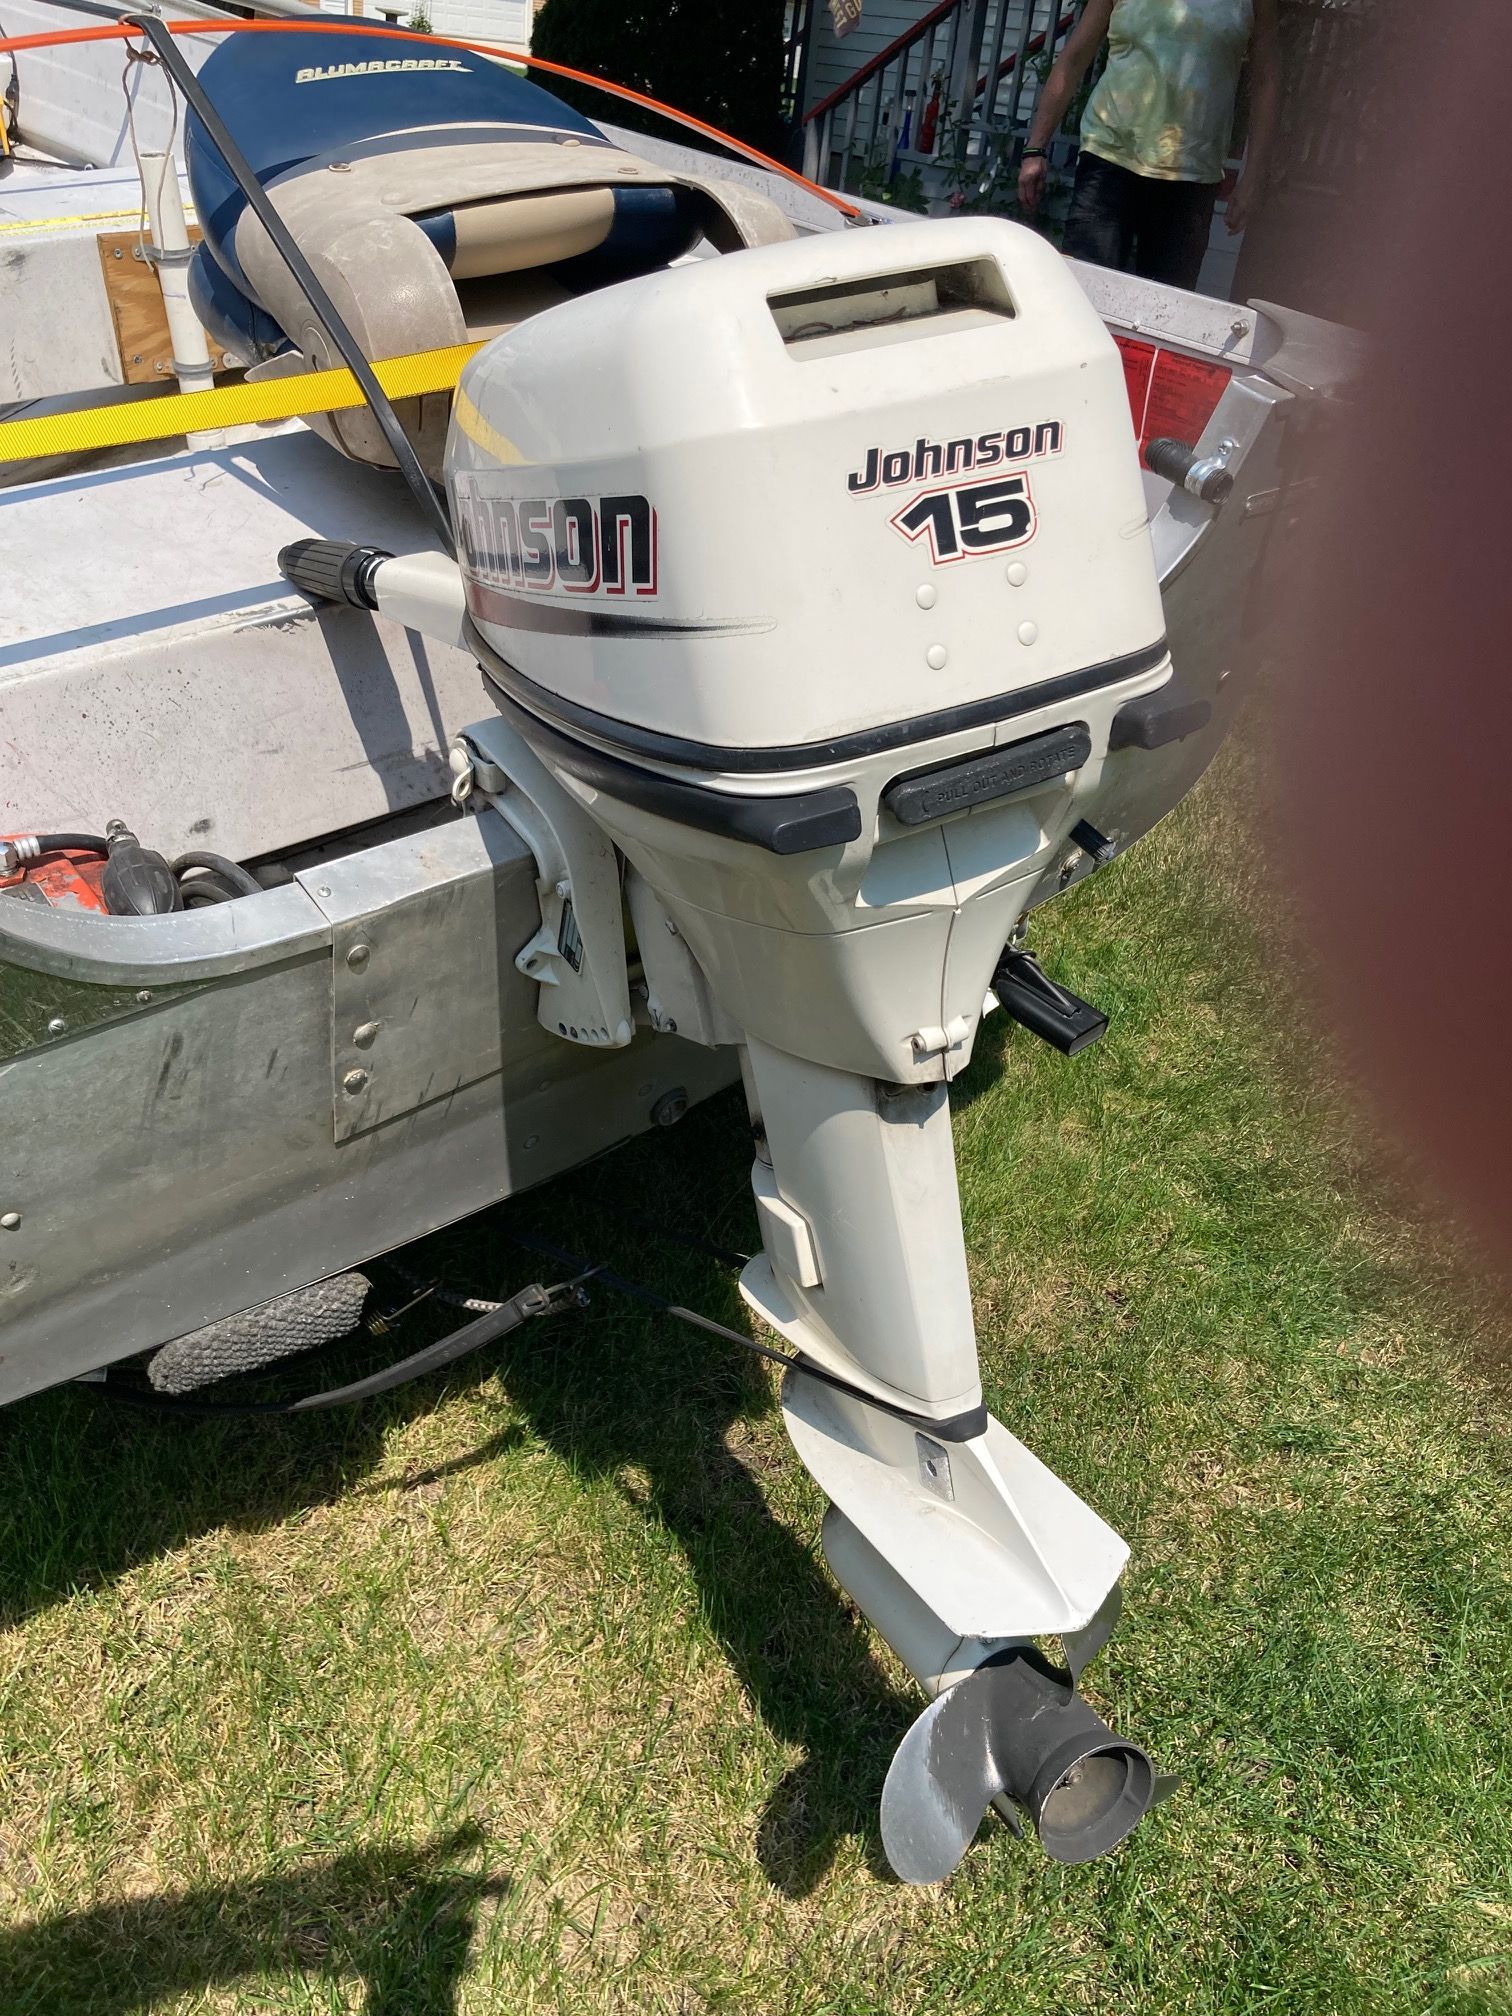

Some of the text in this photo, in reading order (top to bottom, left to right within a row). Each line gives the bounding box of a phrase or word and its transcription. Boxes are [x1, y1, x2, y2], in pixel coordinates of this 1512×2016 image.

[296, 59, 464, 83] ALUMACRAFT
[847, 419, 1064, 494] Johnson
[896, 476, 1034, 560] 15
[937, 746, 1077, 803] PULL OUT AND ROTATE
